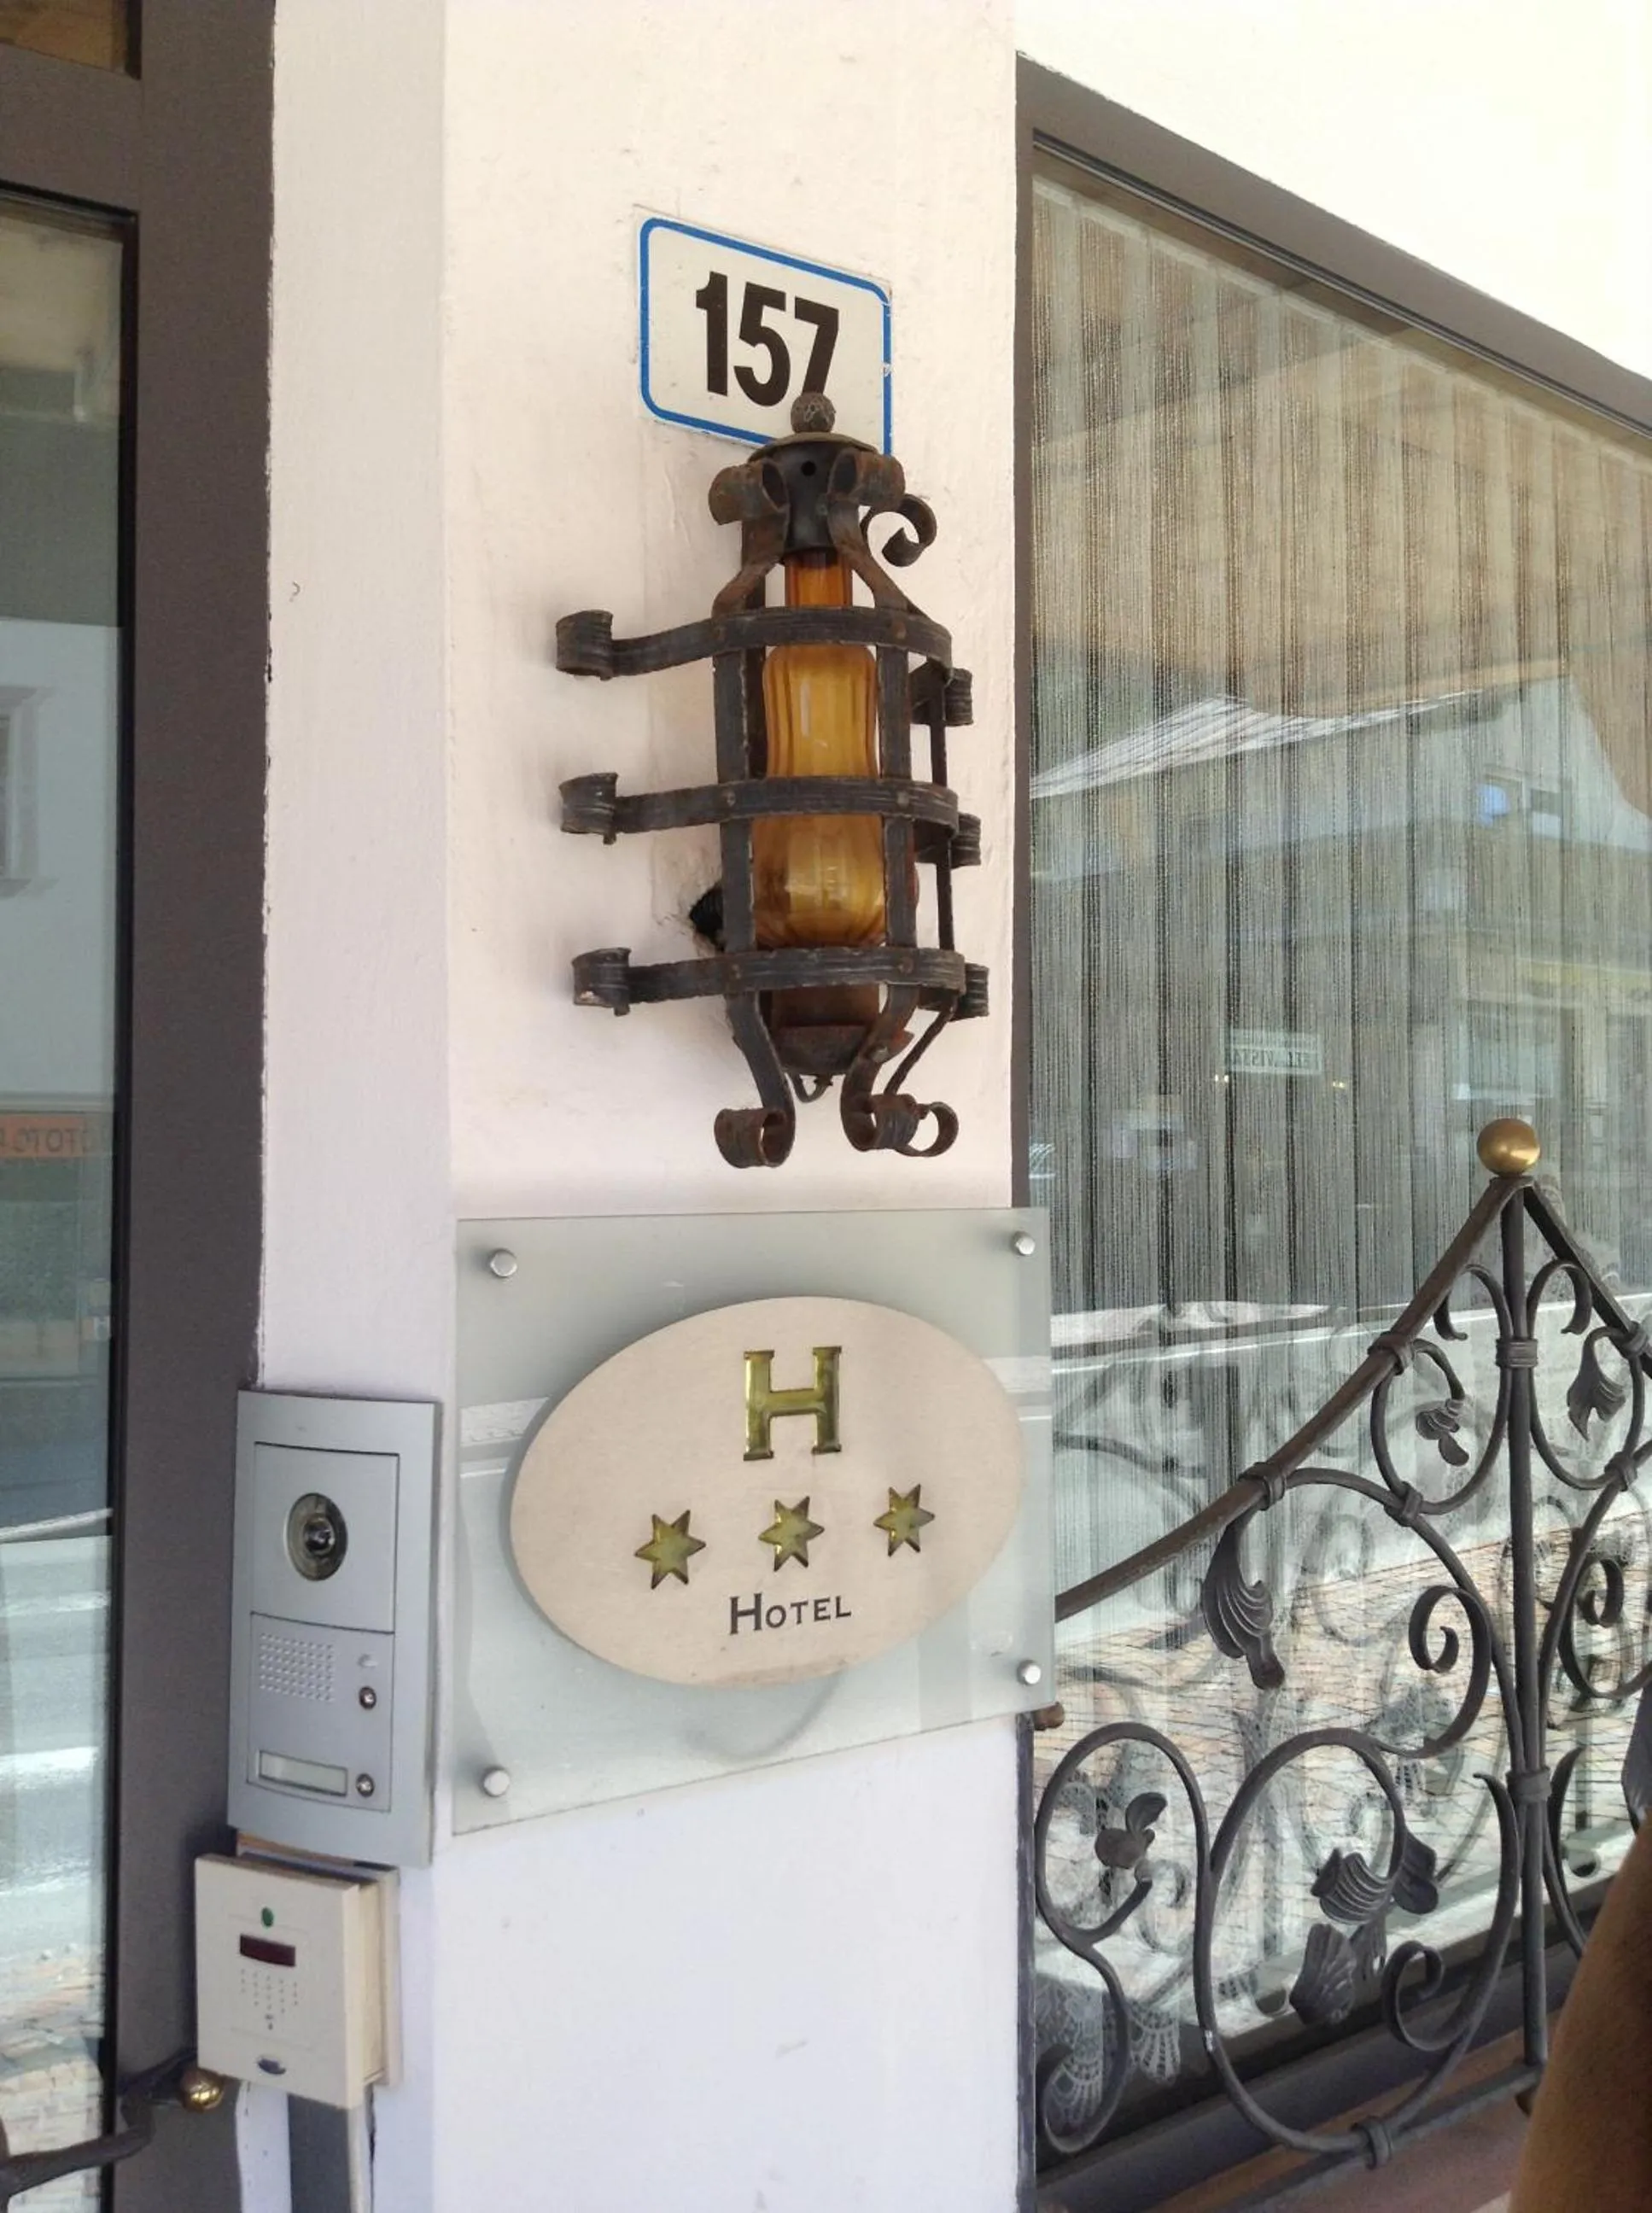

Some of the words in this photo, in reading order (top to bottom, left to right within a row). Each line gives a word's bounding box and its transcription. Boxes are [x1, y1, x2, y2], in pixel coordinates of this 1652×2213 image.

[695, 270, 840, 407] 157
[743, 1345, 843, 1462] H
[729, 1592, 852, 1635] HOTEL
